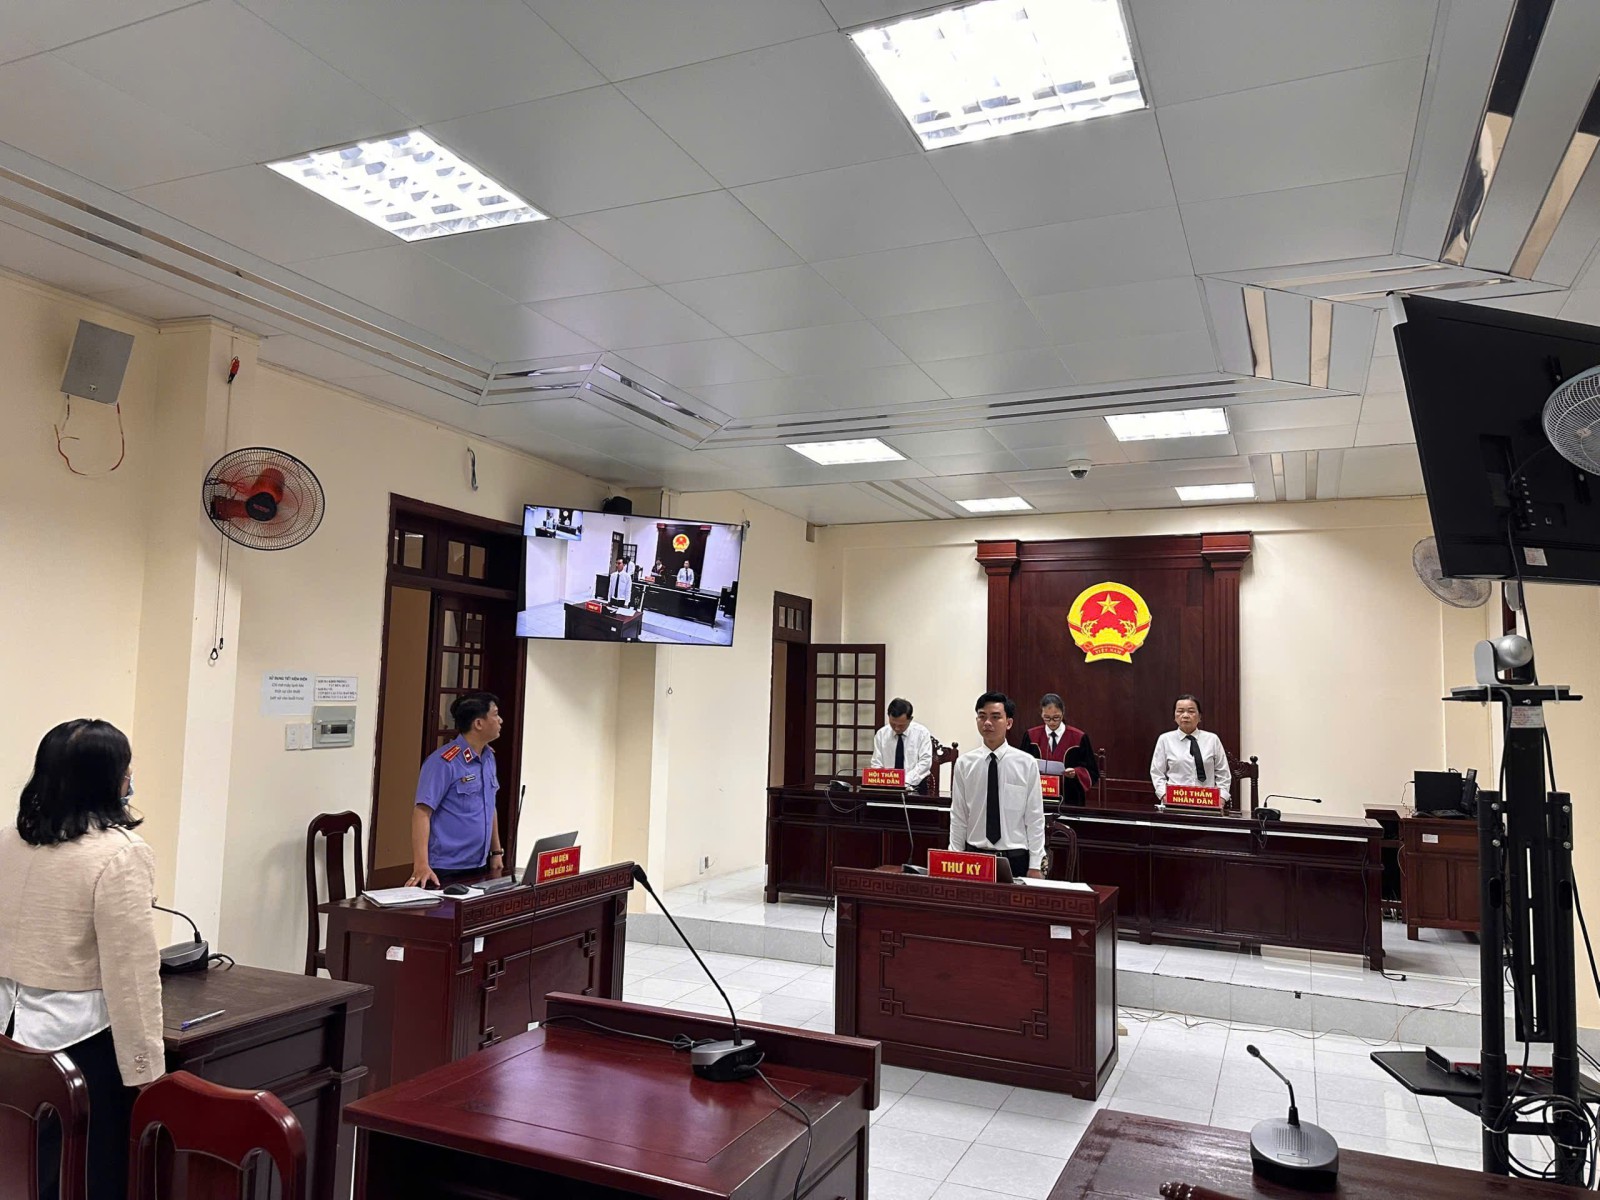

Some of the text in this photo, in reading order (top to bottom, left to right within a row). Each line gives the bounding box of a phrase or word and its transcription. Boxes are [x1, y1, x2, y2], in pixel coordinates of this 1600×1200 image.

[1173, 789, 1212, 798] HỘI THẨM
[1172, 796, 1214, 805] NHÂN DÂN
[544, 868, 554, 877] VIỆN
[555, 864, 565, 874] KIỂM
[941, 861, 981, 876] THƯ KÝ
